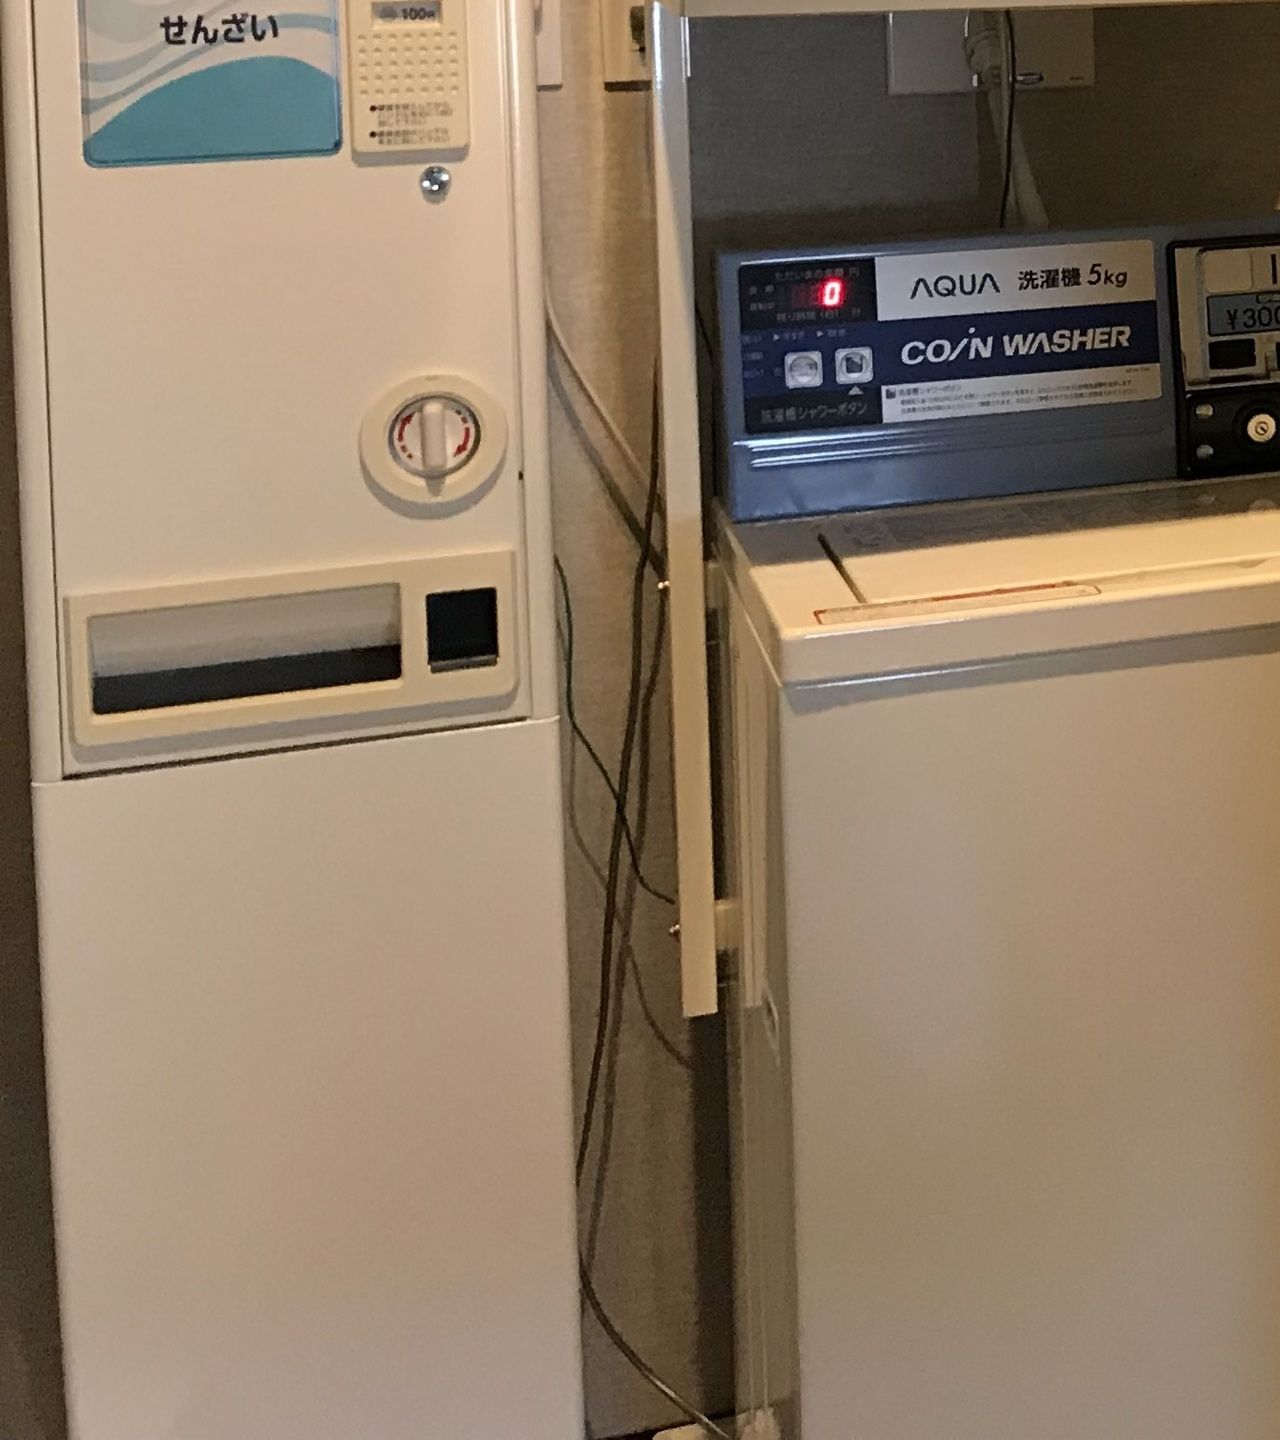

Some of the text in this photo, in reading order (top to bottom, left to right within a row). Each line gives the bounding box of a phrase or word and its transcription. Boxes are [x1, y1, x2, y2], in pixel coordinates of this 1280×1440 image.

[159, 12, 280, 46] せんざい
[400, 7, 436, 22] 100円
[822, 279, 842, 307] 0
[909, 262, 1128, 300] AQUA 洗濯機 5kg
[1002, 324, 1133, 358] WASHER
